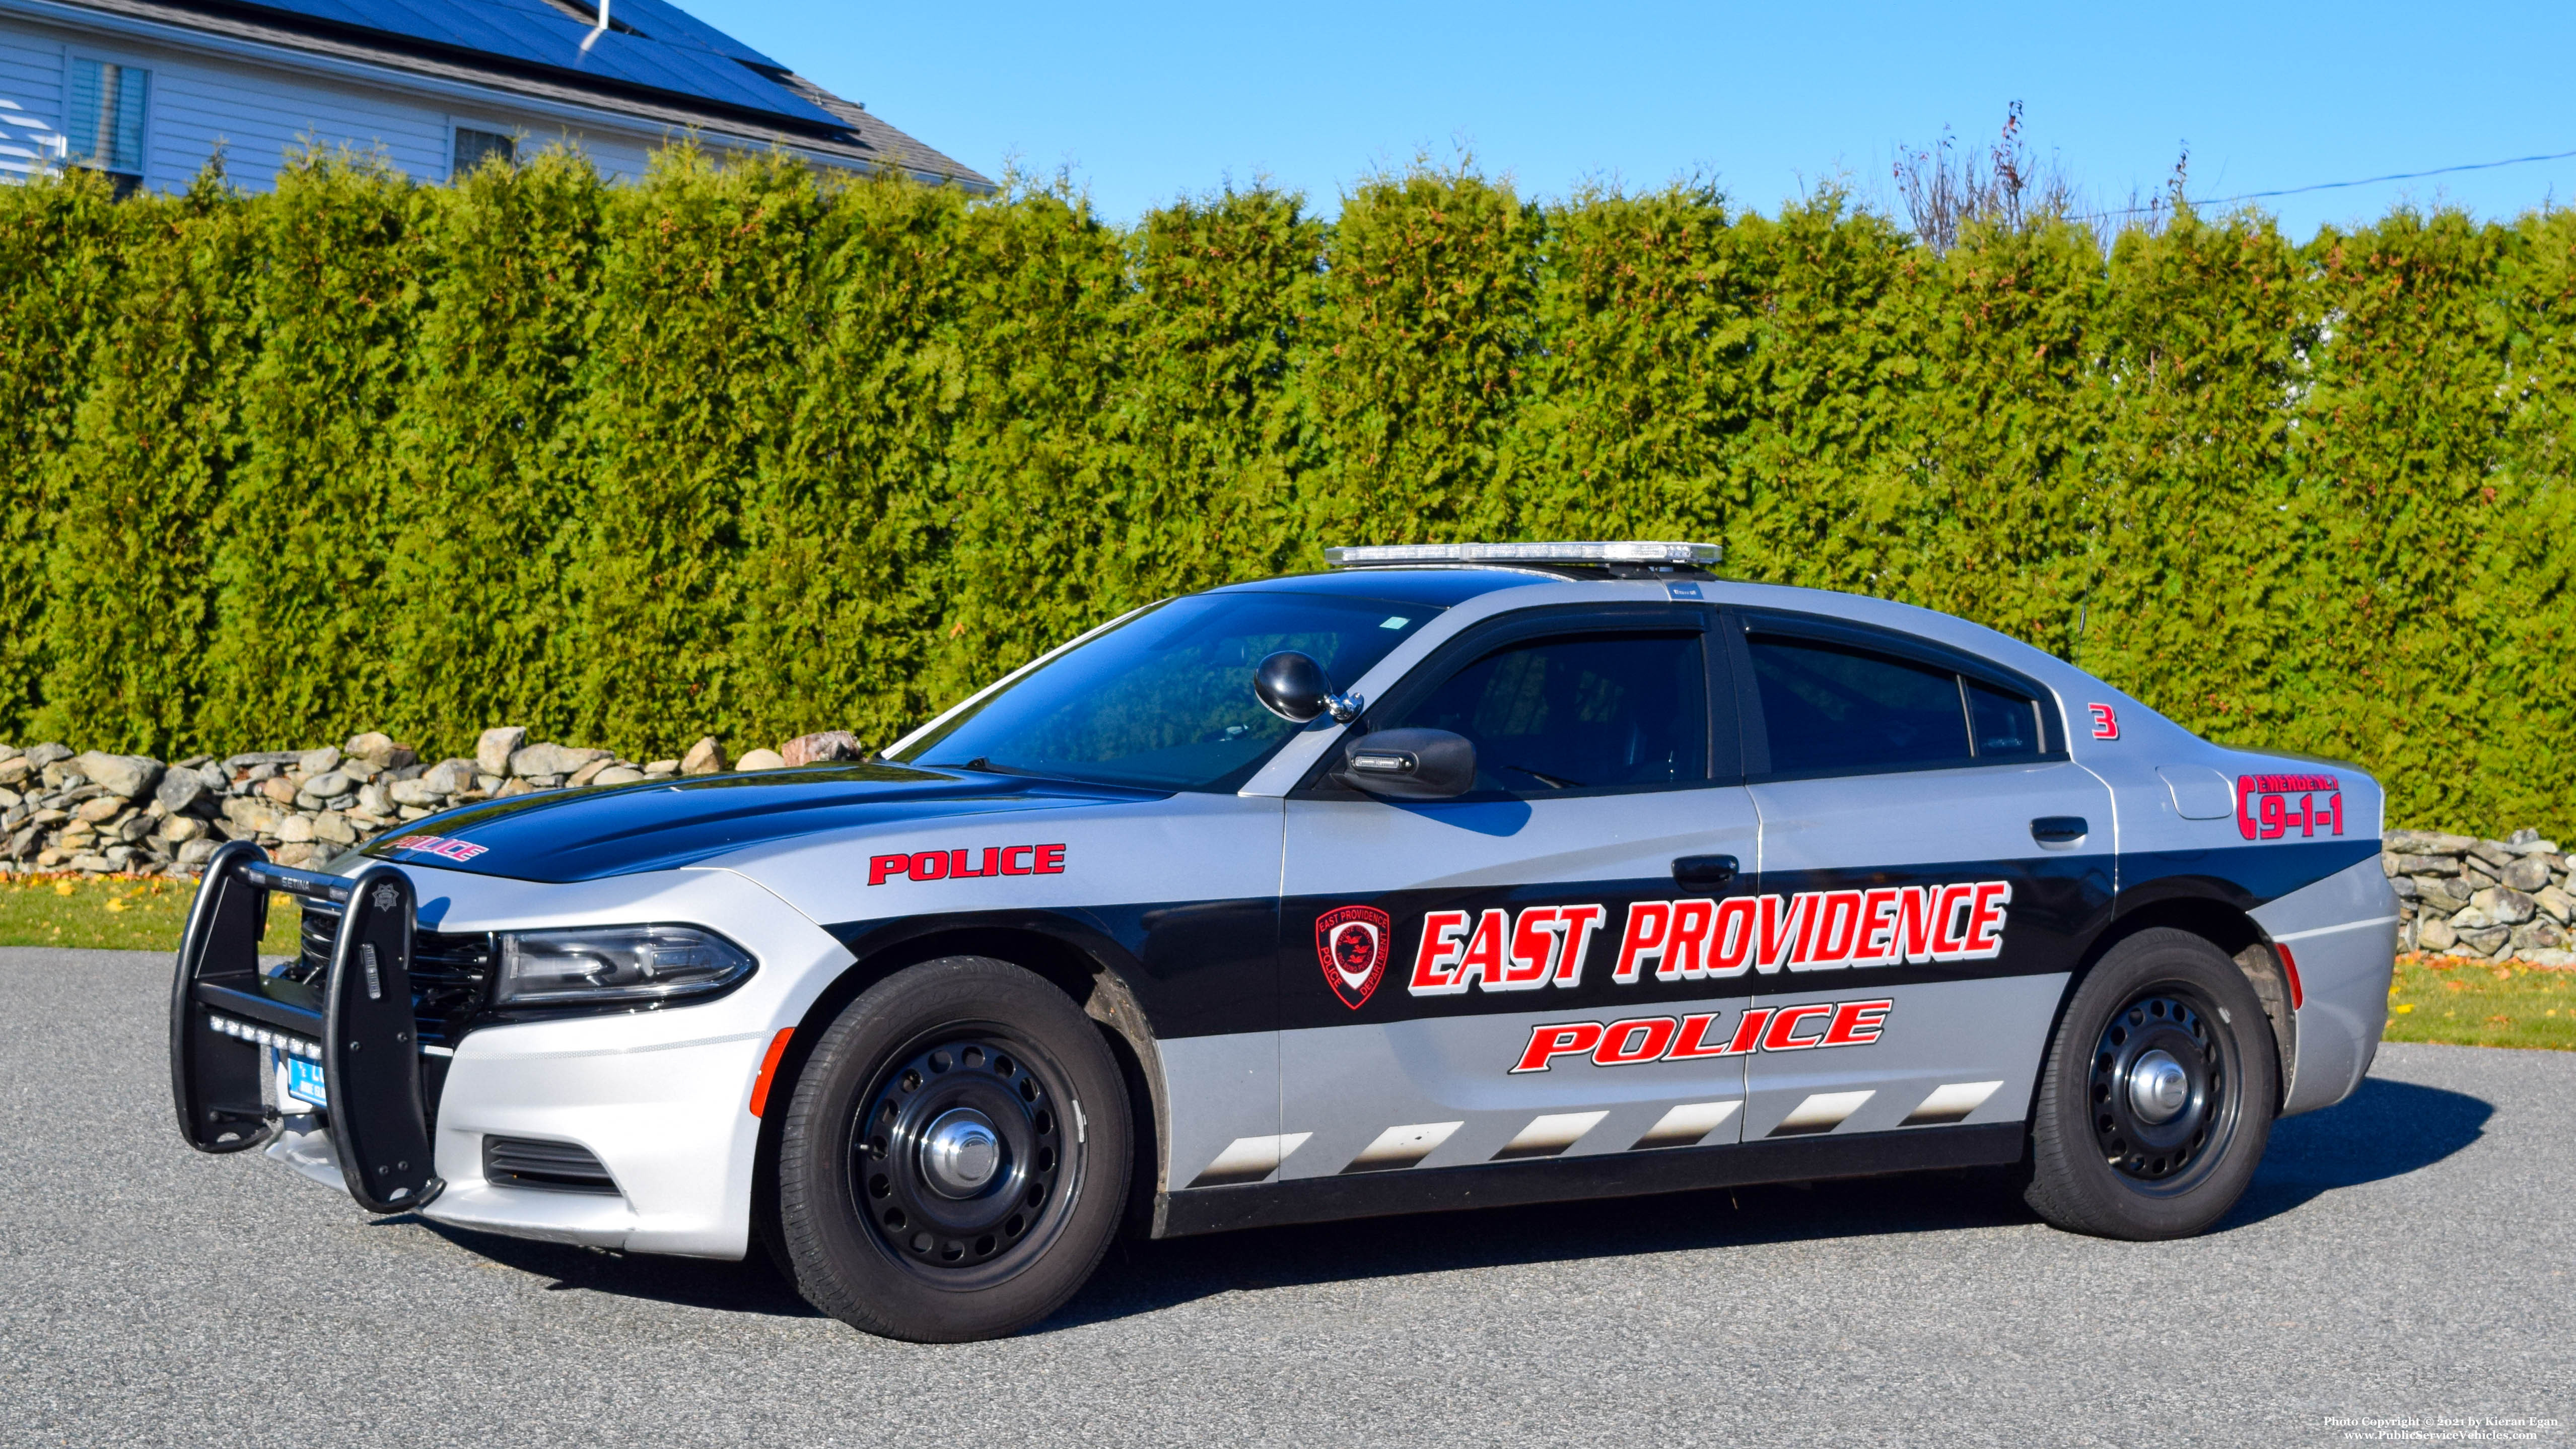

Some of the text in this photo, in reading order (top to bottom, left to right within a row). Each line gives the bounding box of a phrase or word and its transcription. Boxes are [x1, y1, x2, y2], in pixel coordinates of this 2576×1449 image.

[2087, 702, 2120, 740] 3
[2254, 774, 2339, 794] EMERGENCY
[2260, 792, 2343, 840] 9-1-1
[380, 836, 489, 862] POLICE
[867, 843, 1066, 886] POLICE
[282, 876, 310, 891] SETINA
[1319, 910, 1386, 932] EAST PROVIDENCE
[1408, 880, 2012, 997] EAST PROVIDENCE
[1320, 946, 1343, 988] POLICE
[1359, 931, 1387, 996] DEPARTMENT
[1507, 997, 1894, 1075] POLICE
